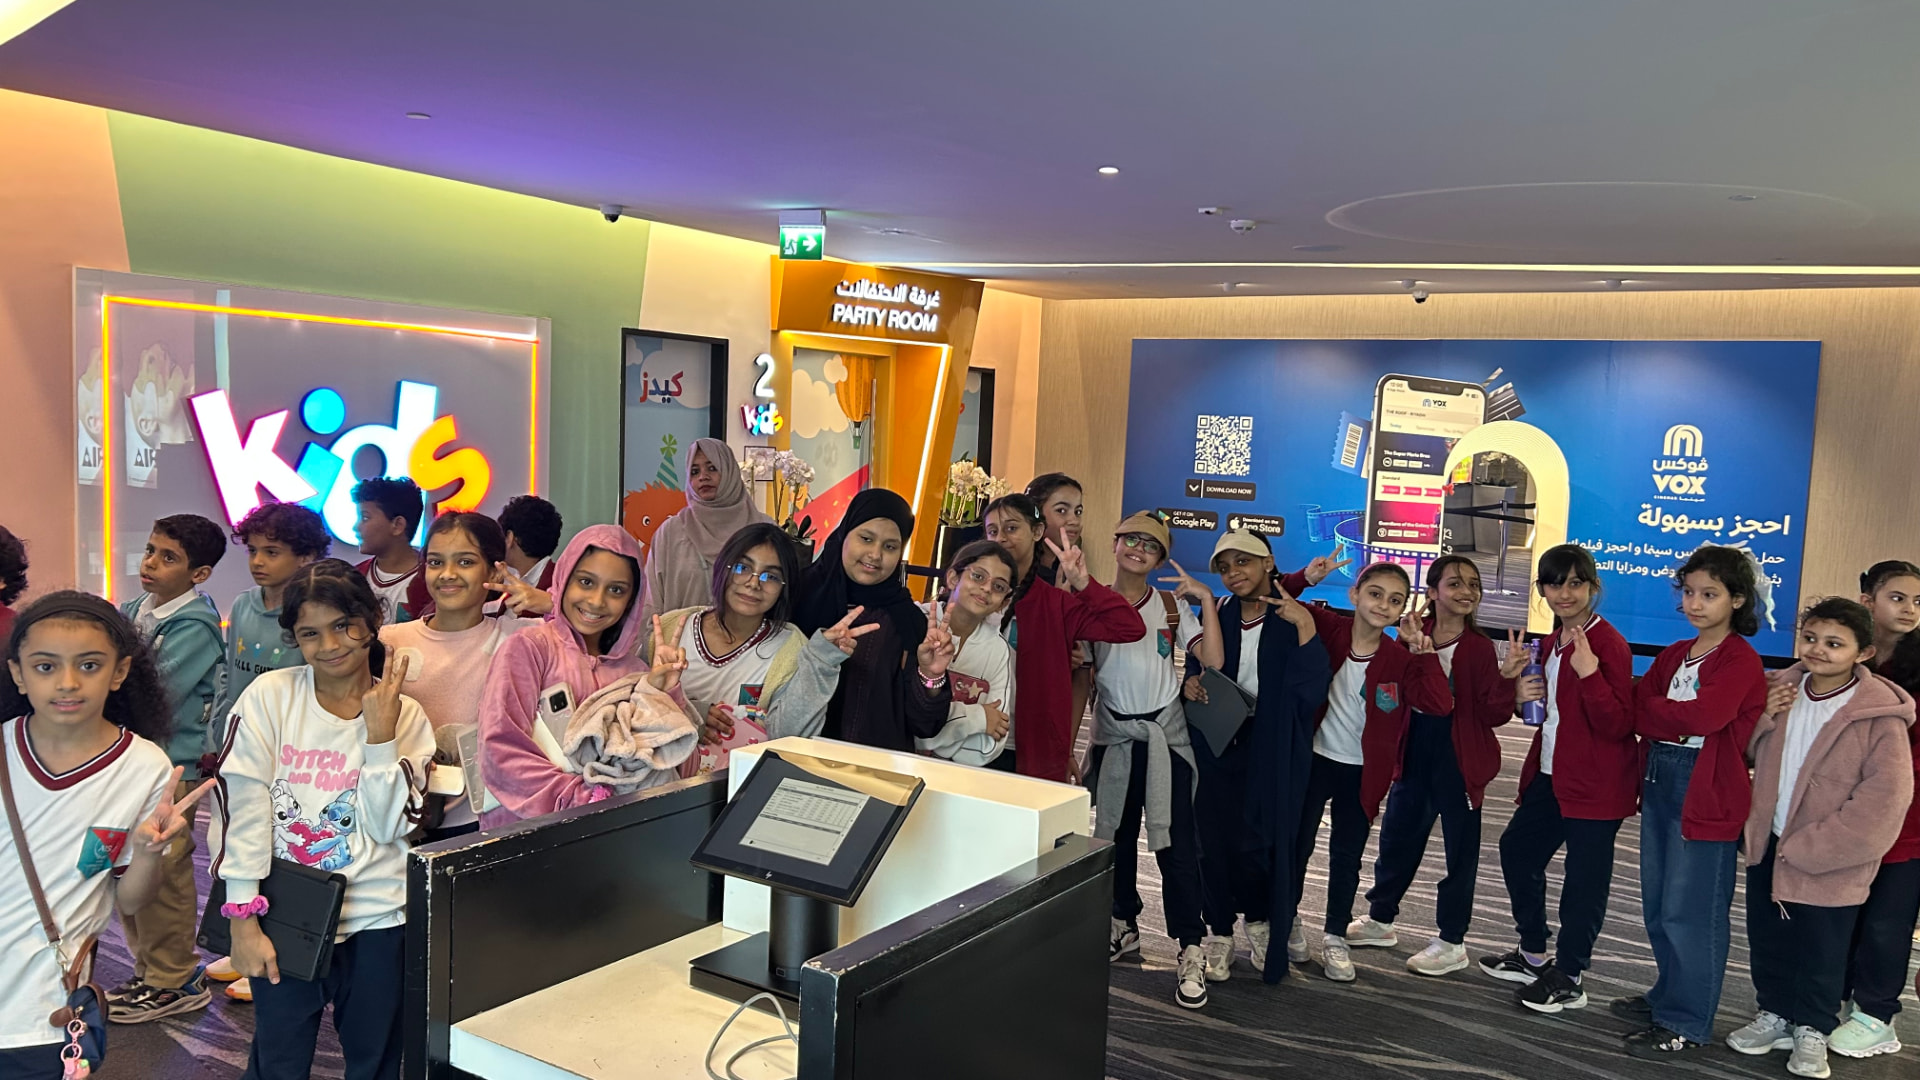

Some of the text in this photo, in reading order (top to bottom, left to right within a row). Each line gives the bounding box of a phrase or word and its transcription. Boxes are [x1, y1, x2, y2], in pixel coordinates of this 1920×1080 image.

[836, 278, 940, 311] غرفة الاحتفالات
[832, 303, 938, 332] PARTY ROOM
[639, 370, 684, 403] كيدز
[754, 353, 775, 398] 2
[1432, 399, 1447, 407] VOX
[740, 402, 783, 436] kids
[190, 379, 491, 548] kids
[1206, 486, 1238, 494] DOWNLOAD
[1651, 474, 1707, 495] VOX
[1172, 516, 1216, 529] Google Play
[1259, 523, 1281, 533] Store
[1638, 503, 1791, 539] احجز بسهولة
[1604, 542, 1632, 553] احجز
[1755, 552, 1785, 565] حمل
[280, 744, 347, 772] STITCH
[314, 769, 360, 792] ANG
